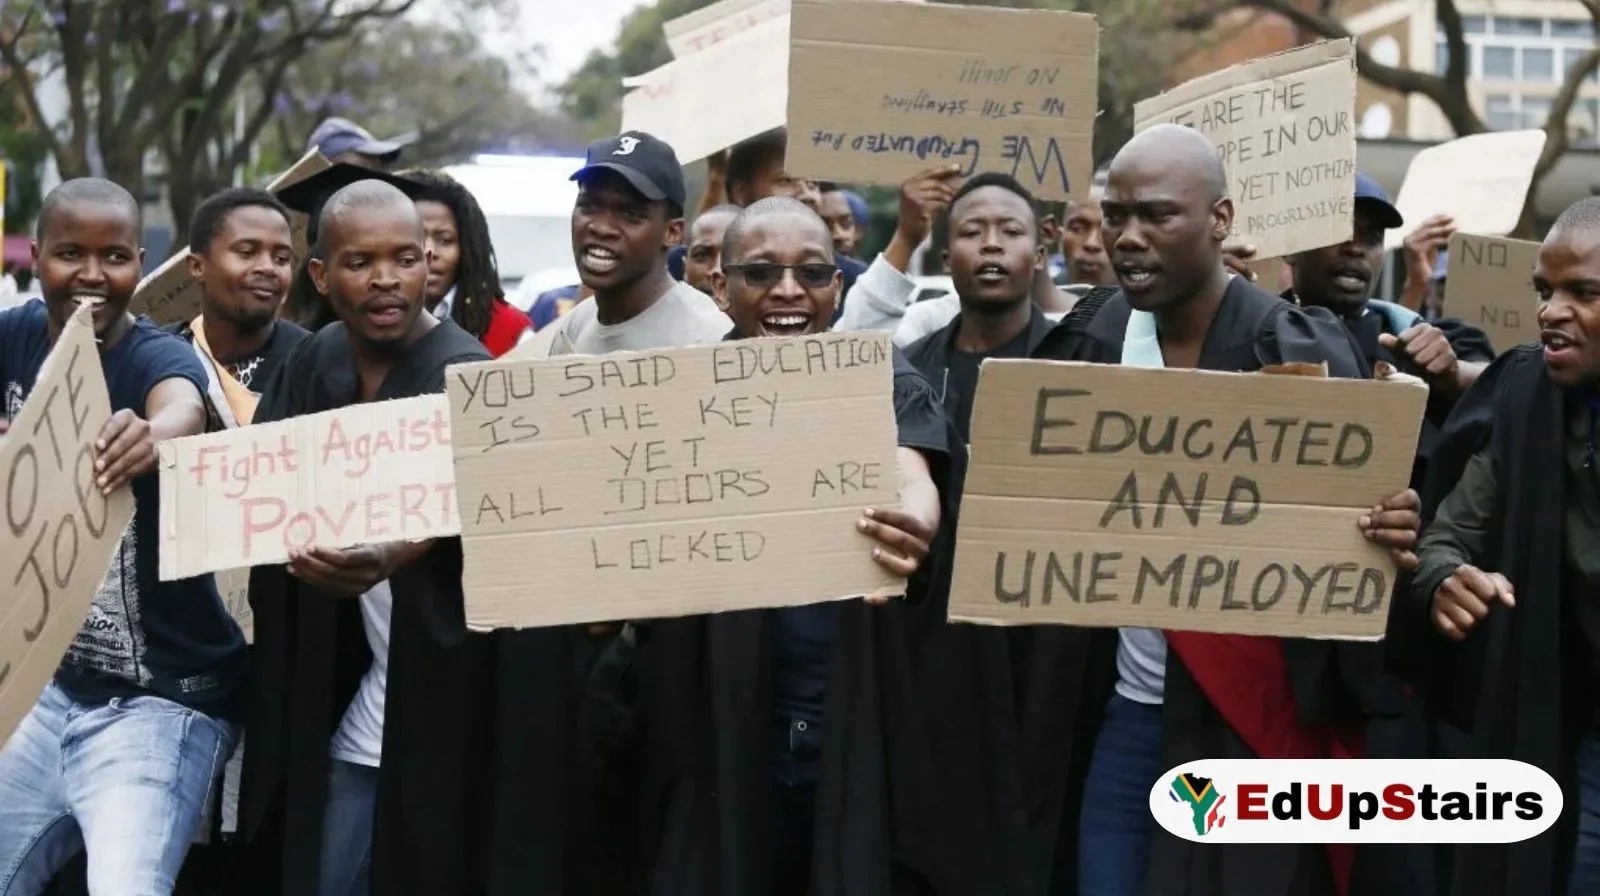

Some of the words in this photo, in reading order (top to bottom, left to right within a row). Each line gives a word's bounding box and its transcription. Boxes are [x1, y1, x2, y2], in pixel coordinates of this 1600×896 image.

[1026, 66, 1061, 86] NO
[1170, 110, 1194, 128] E
[1201, 94, 1245, 133] ARE
[1254, 81, 1305, 117] THE
[1002, 135, 1071, 193] WE
[1215, 136, 1254, 165] OPE
[1262, 122, 1297, 157] IN
[1307, 111, 1349, 142] OUR
[1237, 172, 1280, 204] YET
[1460, 238, 1508, 268] NO
[1480, 305, 1520, 329] NO
[457, 367, 535, 413] YOU
[558, 355, 676, 397] SAID
[712, 339, 888, 384] EDUCATION
[7, 345, 90, 538] OTE
[480, 416, 540, 452] IS
[573, 403, 659, 436] THE
[699, 391, 779, 428] KEY
[1030, 387, 1375, 468] EDUCATED
[189, 435, 298, 499] Fight
[611, 437, 706, 476] YET
[240, 482, 455, 557] POVERT
[475, 487, 563, 525] ALL
[604, 470, 771, 515] DOORS
[811, 462, 881, 498] ARE
[1099, 469, 1262, 529] AND
[590, 529, 767, 570] LOCKED
[994, 549, 1388, 616] UNEMPLOYED
